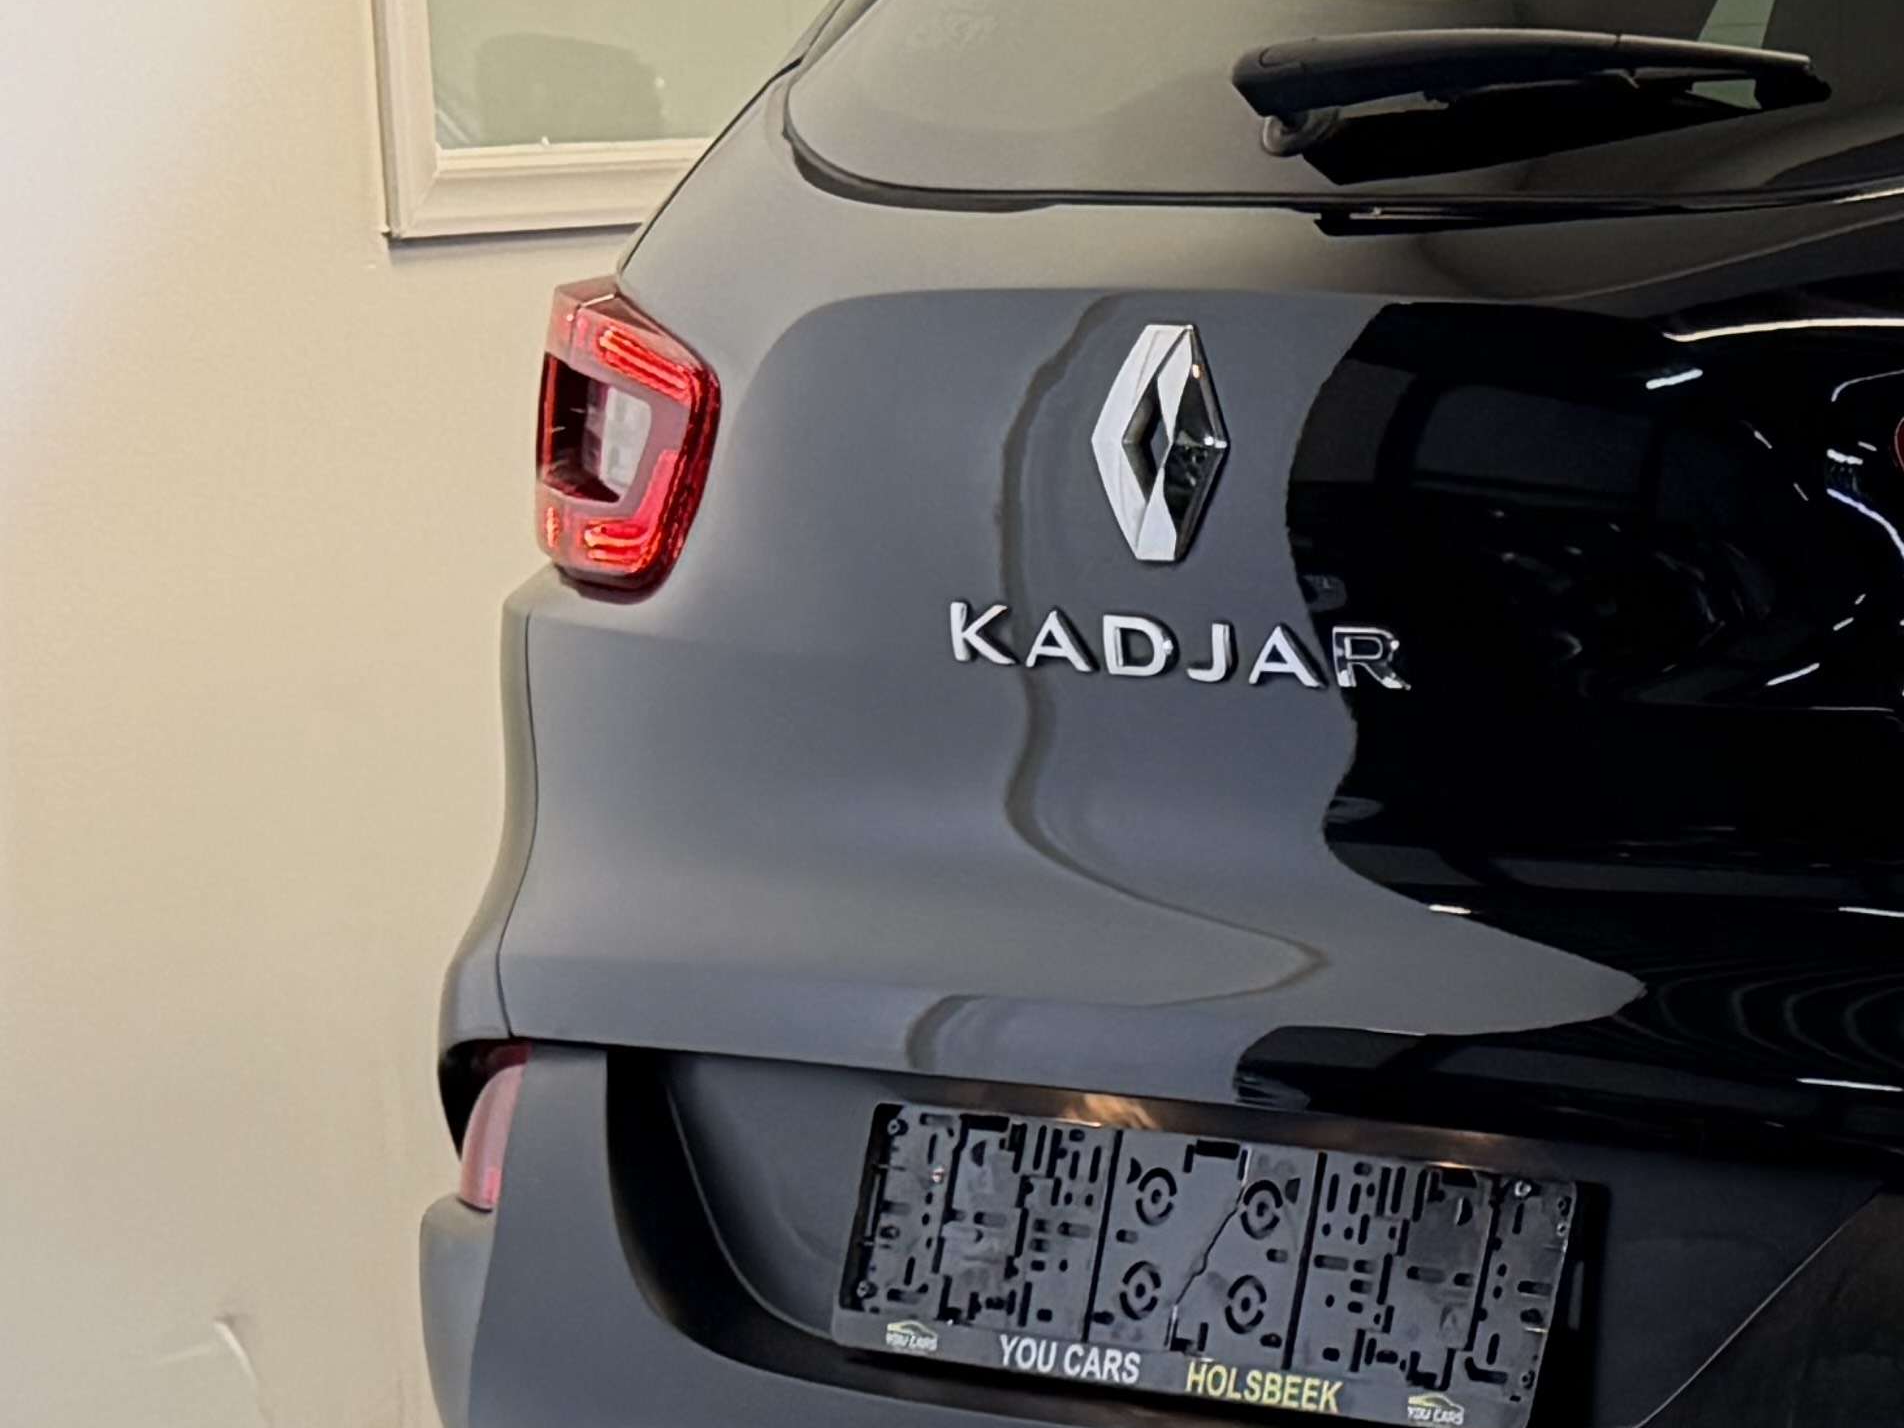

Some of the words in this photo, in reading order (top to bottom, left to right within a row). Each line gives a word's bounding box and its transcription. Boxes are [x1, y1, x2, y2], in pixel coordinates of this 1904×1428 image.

[949, 600, 1411, 690] KADJAR
[999, 1333, 1057, 1373] YOU
[1062, 1343, 1142, 1385] CARS
[1185, 1360, 1344, 1414] HOLSBEEK
